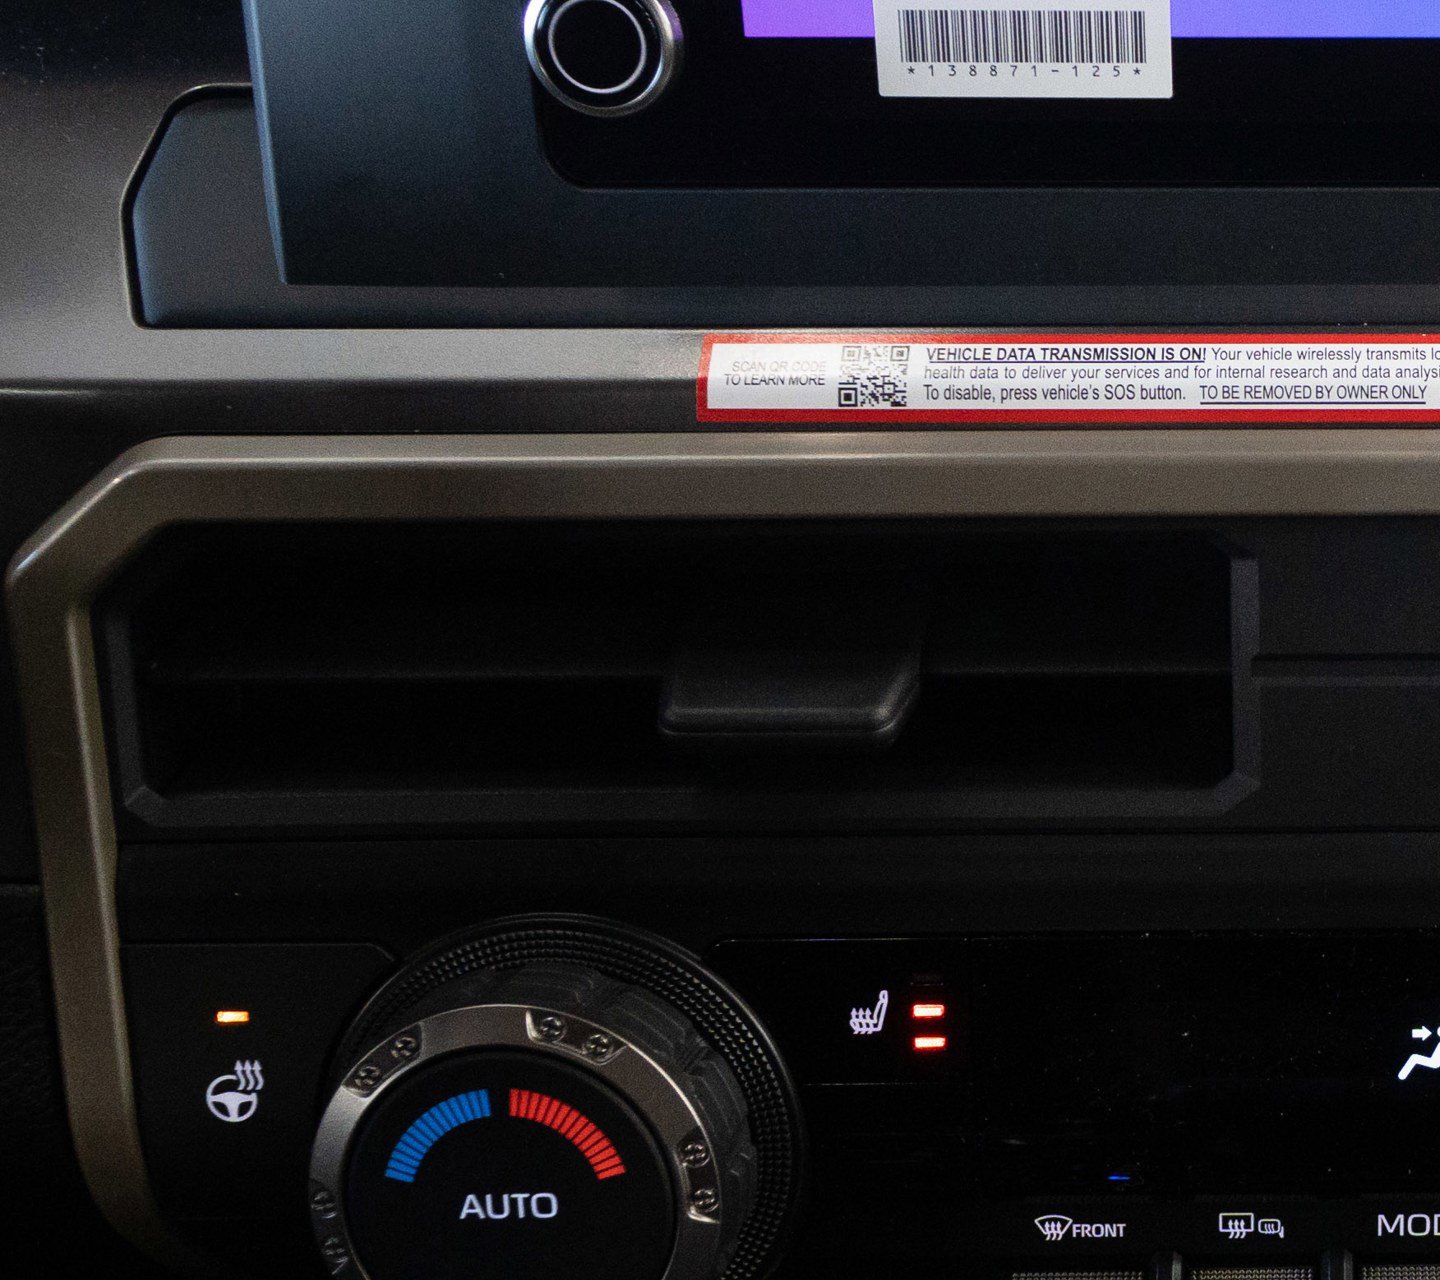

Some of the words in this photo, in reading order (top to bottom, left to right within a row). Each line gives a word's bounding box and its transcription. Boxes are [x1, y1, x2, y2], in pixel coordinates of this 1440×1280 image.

[926, 347, 992, 361] VEHICLE
[997, 347, 1037, 361] DATA
[1042, 347, 1156, 361] TRANSMISSION
[1162, 347, 1175, 361] IS
[1179, 347, 1206, 361] ON!
[1212, 347, 1242, 360] Your
[1246, 347, 1292, 360] vehicle
[1297, 347, 1361, 363] wirelessly
[1366, 347, 1427, 360] transmits
[732, 361, 770, 373] SCAN
[771, 361, 789, 373] QR
[792, 361, 826, 373] CODE
[924, 365, 965, 379] health
[970, 366, 999, 379] data
[1004, 366, 1016, 379] to
[1022, 365, 1066, 379] deliver
[1071, 368, 1100, 382] your
[1104, 365, 1160, 379] services
[1164, 365, 1189, 379] and
[1194, 365, 1211, 379] for
[1216, 365, 1265, 379] internal
[1270, 365, 1328, 379] research
[1333, 365, 1357, 379] and
[1362, 365, 1390, 379] data
[724, 374, 740, 386] TO
[744, 374, 785, 386] LEARN
[788, 374, 826, 386] MORE
[923, 384, 939, 400] To
[944, 384, 996, 403] disable,
[1000, 388, 1037, 404] press
[1104, 384, 1135, 400] SOS
[1140, 384, 1186, 400] button.
[1200, 385, 1218, 400] TO
[1222, 385, 1240, 400] BE
[1244, 385, 1312, 400] REMOVED
[1316, 385, 1334, 400] BY
[1336, 385, 1389, 400] OWNER
[1392, 385, 1427, 400] ONLY
[458, 1191, 559, 1220] AUTO
[1072, 1223, 1127, 1238] FRONT
